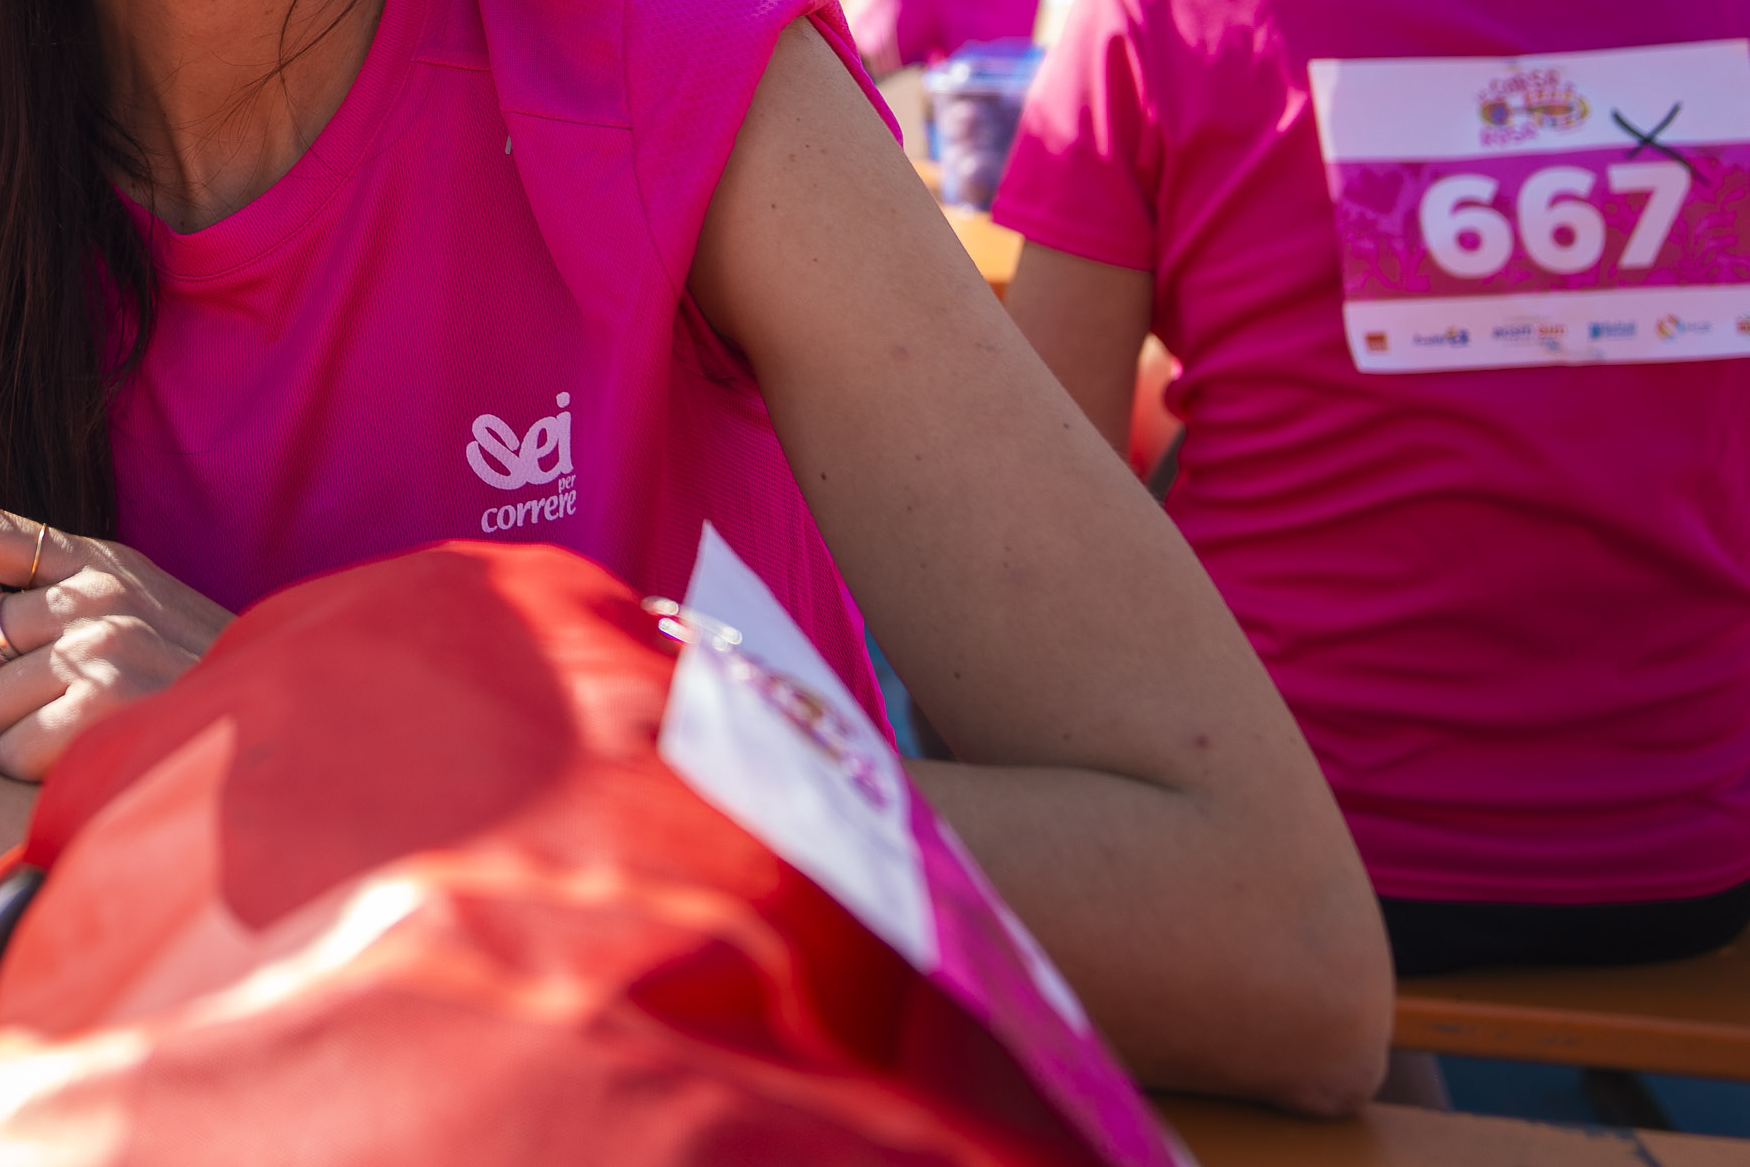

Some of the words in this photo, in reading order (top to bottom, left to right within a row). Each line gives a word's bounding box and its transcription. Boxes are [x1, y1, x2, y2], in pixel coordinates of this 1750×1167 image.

[1418, 161, 1692, 280] 667
[557, 473, 577, 494] per
[480, 489, 577, 534] correre
